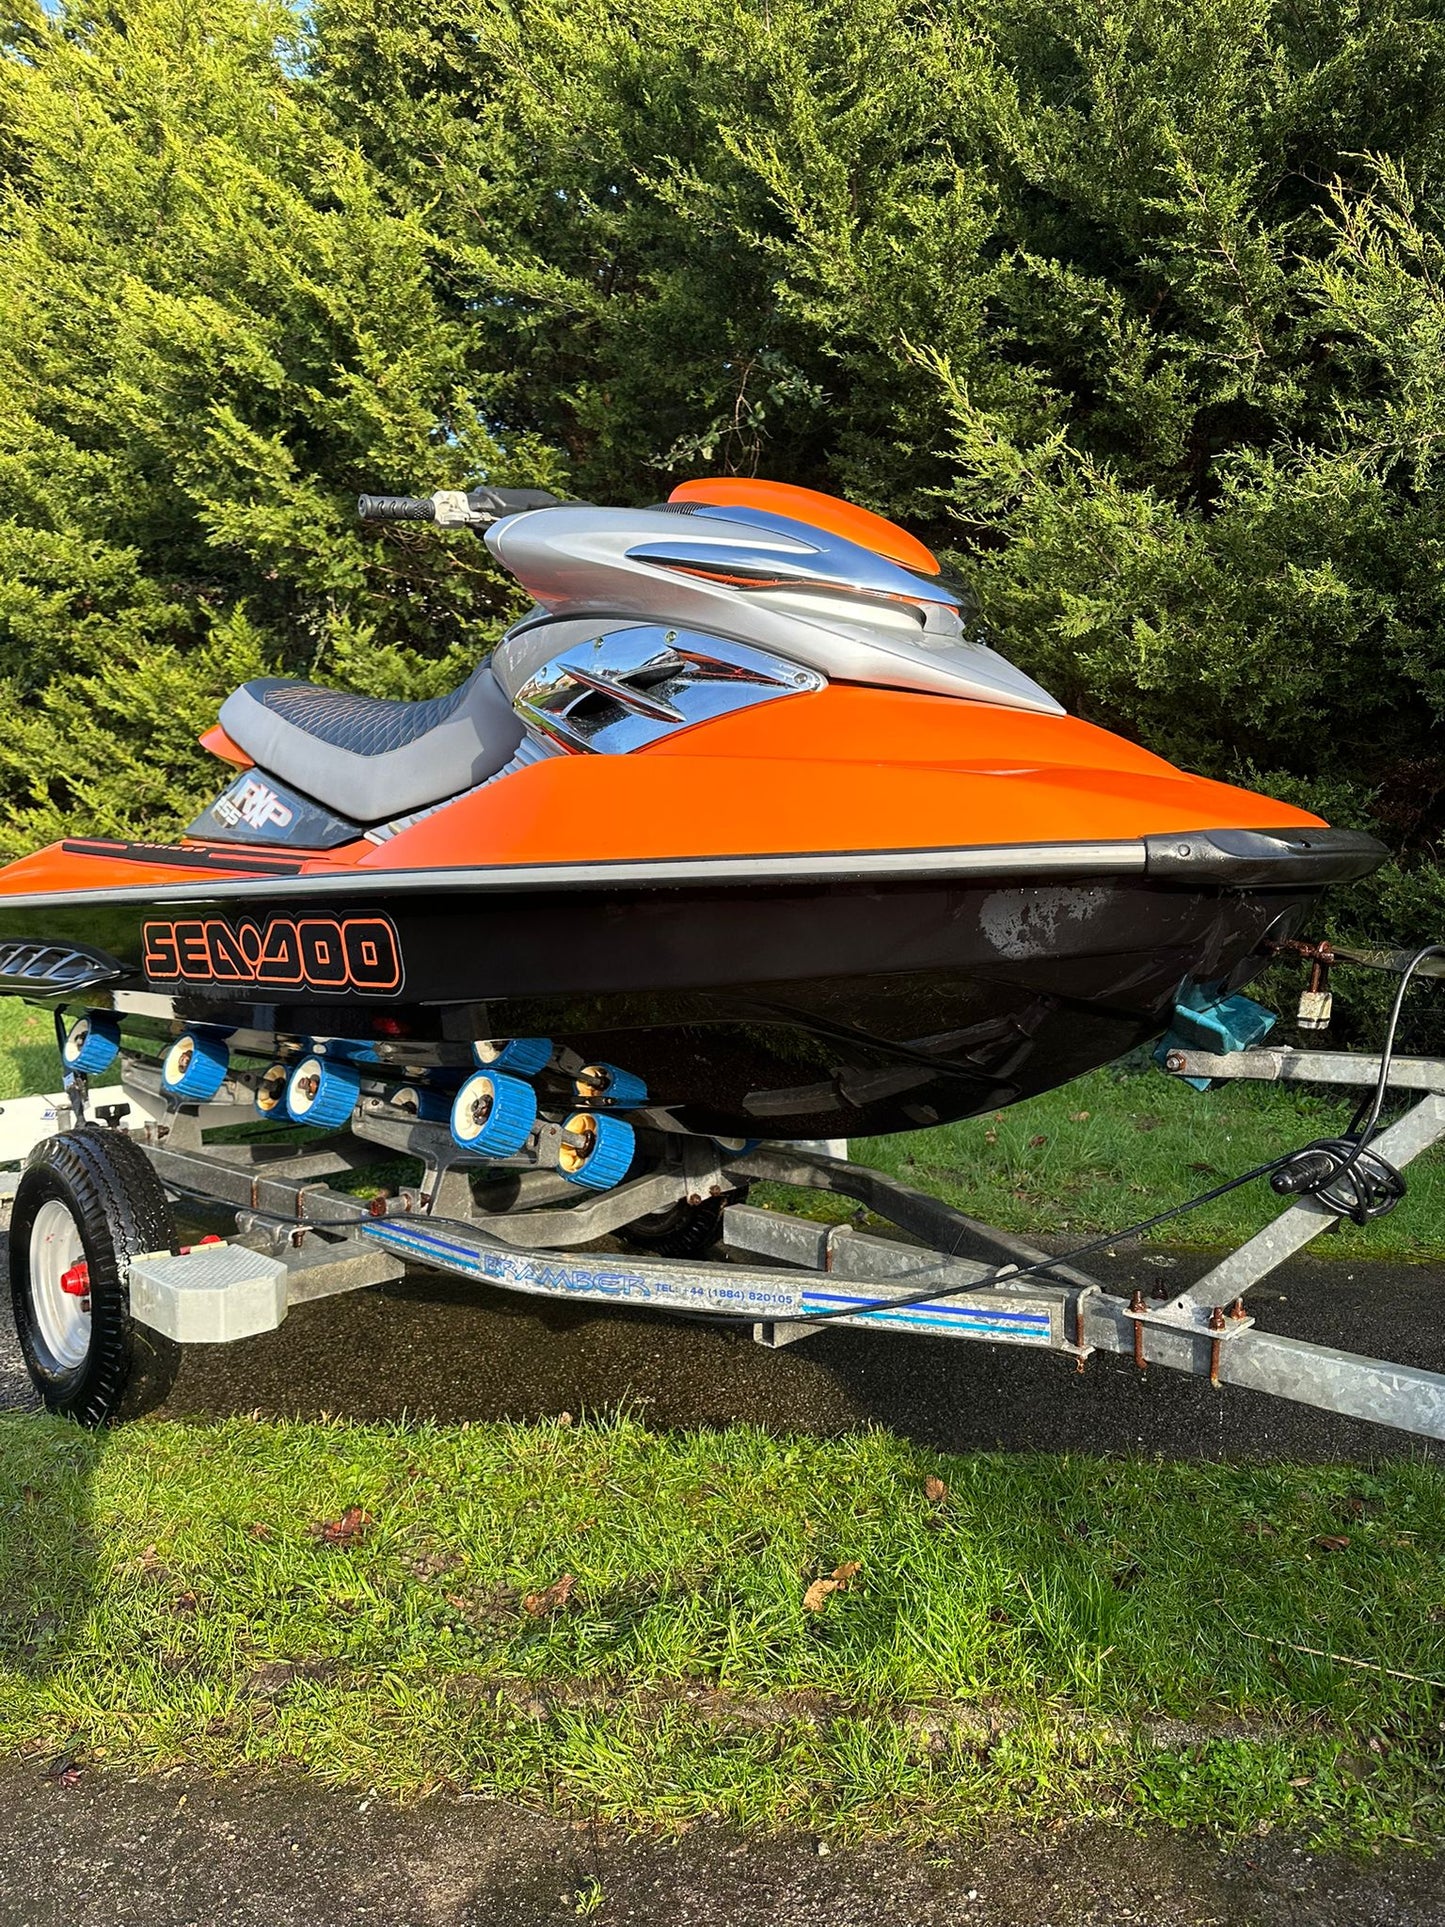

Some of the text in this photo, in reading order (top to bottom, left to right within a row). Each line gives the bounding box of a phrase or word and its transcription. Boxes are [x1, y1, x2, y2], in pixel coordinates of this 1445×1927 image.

[484, 1255, 651, 1297] BRAMBER
[655, 1282, 679, 1294] TEL:
[707, 1288, 745, 1301] (1884)
[748, 1291, 793, 1305] 820105
